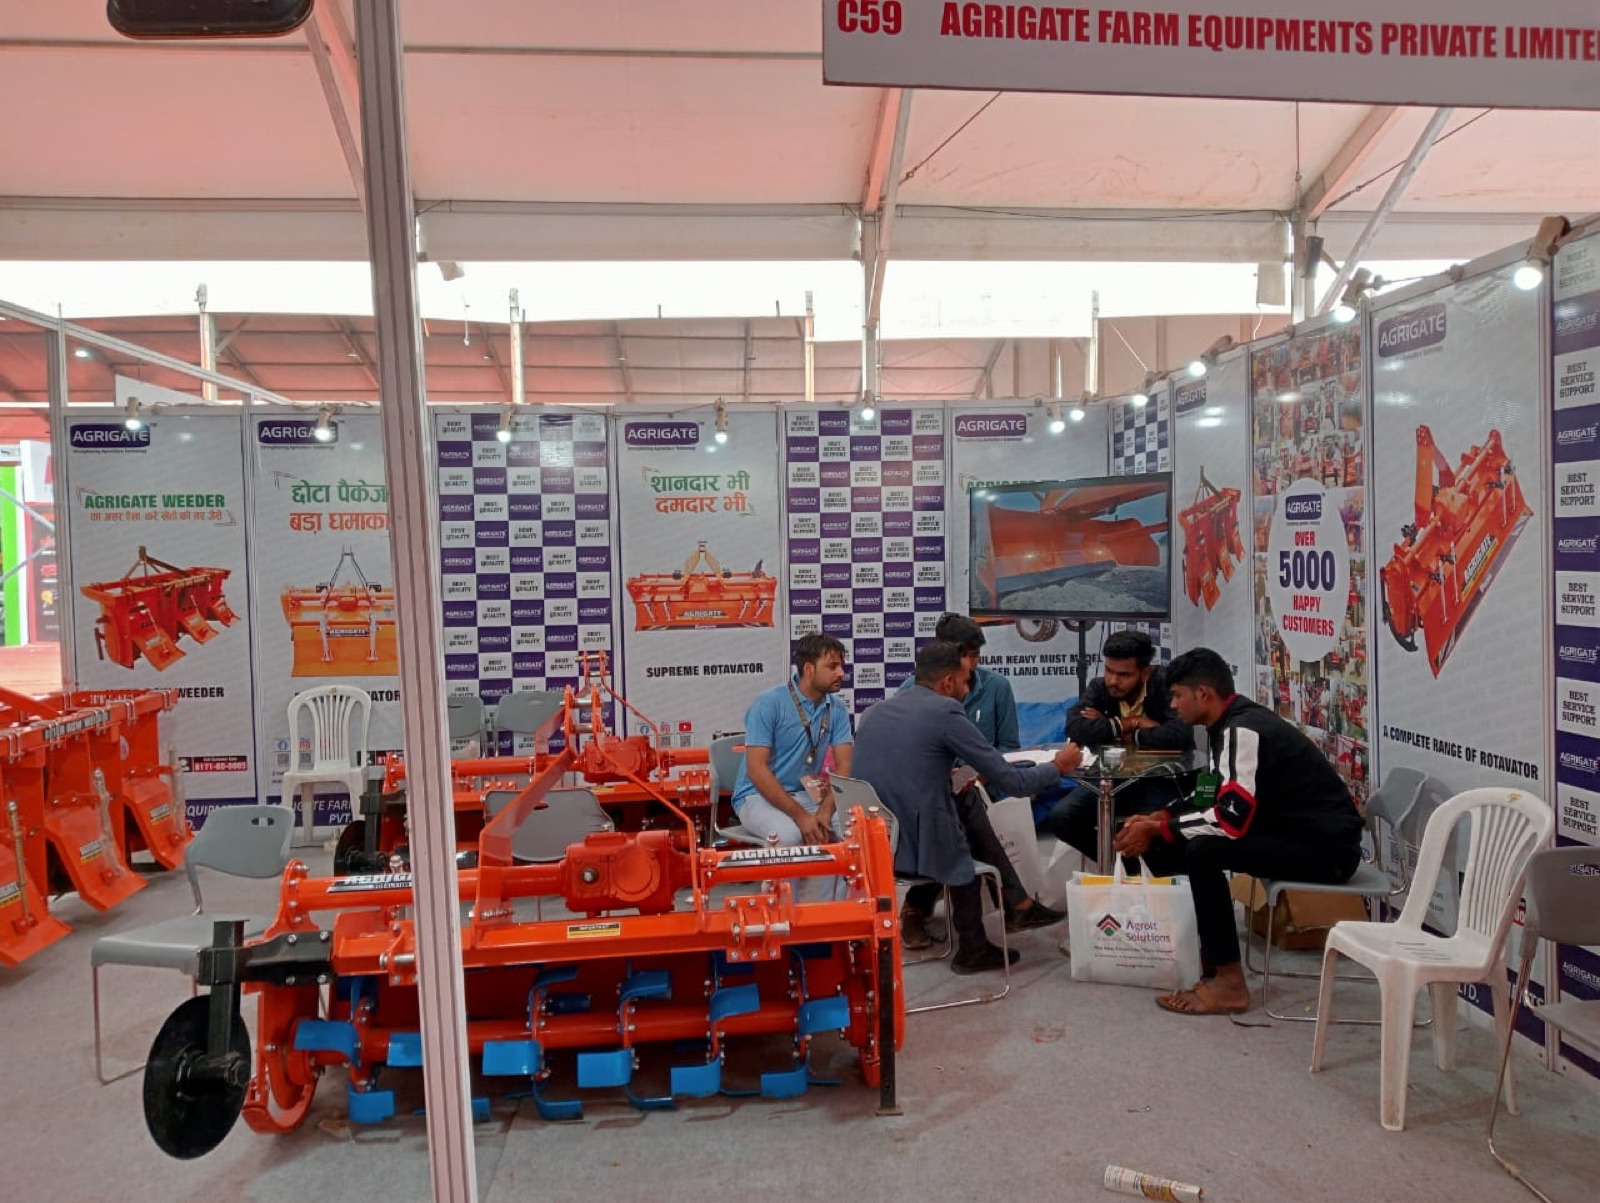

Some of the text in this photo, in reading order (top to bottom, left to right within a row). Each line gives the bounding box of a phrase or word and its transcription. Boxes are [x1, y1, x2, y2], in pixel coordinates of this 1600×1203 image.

[837, 0, 901, 34] C59
[940, 3, 1600, 61] AGRIGATE FARM EQUIPMENTS PRIVATE LIMITE
[1380, 312, 1445, 349] AGRIGATE
[1566, 362, 1588, 374] BEST
[1560, 372, 1595, 386] SERVICE
[1560, 384, 1596, 398] SUPPORT
[260, 426, 336, 438] AGRIGAE
[957, 420, 1026, 432] AGRIGATE
[1558, 426, 1597, 440] AGRIGATE
[73, 430, 148, 442] AGRIGATE
[627, 428, 697, 440] AGRIGATE
[650, 470, 750, 493] शानदार भी
[1567, 472, 1588, 483] BEST
[1560, 484, 1595, 495] SERVICE
[84, 494, 225, 508] AGRIGATE WEEDER
[655, 492, 748, 514] दमदार भी
[1286, 500, 1321, 514] AGRIGATE
[1560, 495, 1596, 506] SUPPORT
[1294, 530, 1316, 547] OVER
[1558, 538, 1597, 548] AGRIGATE
[1280, 550, 1336, 592] 5000
[1568, 582, 1588, 592] BEST
[1293, 594, 1321, 612] HAPPY
[1562, 594, 1596, 604] SERVICE
[1560, 605, 1596, 616] SUPPORT
[1283, 614, 1334, 637] CUSTOMERS
[1006, 654, 1036, 664] HEAVY
[1040, 654, 1066, 664] MUST
[1559, 645, 1598, 660] AGRIGATE
[646, 662, 764, 678] SUPREME ROTAVATOR
[1014, 666, 1038, 677] LAND
[1569, 691, 1588, 702] BEST
[1562, 701, 1596, 715] SERVICE
[1562, 712, 1597, 726] SUPPORT
[1384, 724, 1538, 780] A COMPLETE RANGE OF ROTAVATOR
[1560, 752, 1599, 770] AGRIGATE
[1570, 796, 1590, 811] BEST
[1564, 806, 1597, 824] SERVICE
[1562, 816, 1598, 836] SUPPORT
[730, 846, 821, 860] AGRIGATE
